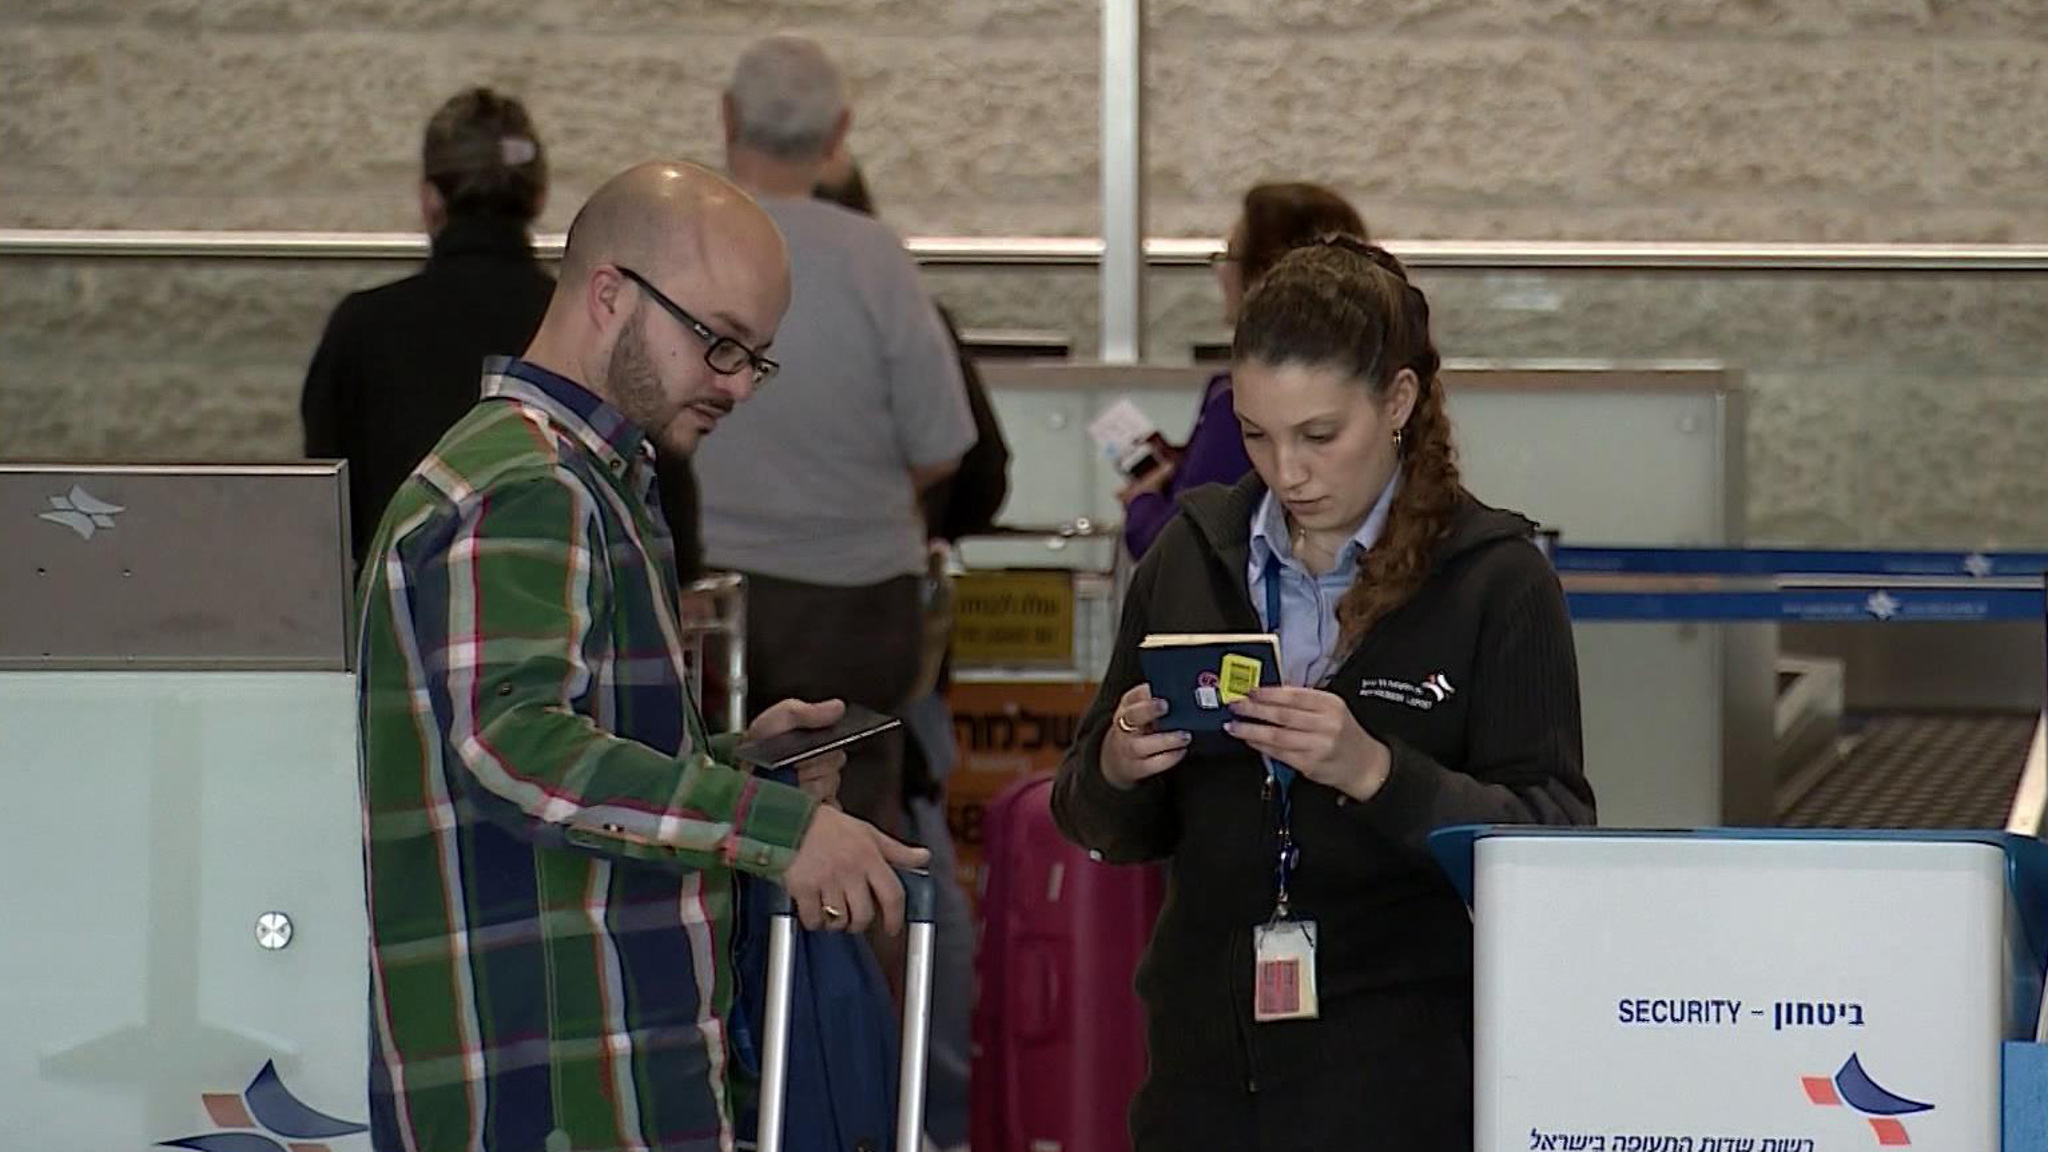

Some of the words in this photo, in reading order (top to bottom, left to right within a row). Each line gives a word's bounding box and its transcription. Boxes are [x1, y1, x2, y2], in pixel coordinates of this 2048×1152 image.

[1618, 999, 1741, 1024] SECURITY
[1774, 1002, 1864, 1030] ביטחון
[1530, 1128, 1605, 1152] בישראל
[1612, 1134, 1693, 1152] התעופה
[1701, 1137, 1754, 1152] שדות
